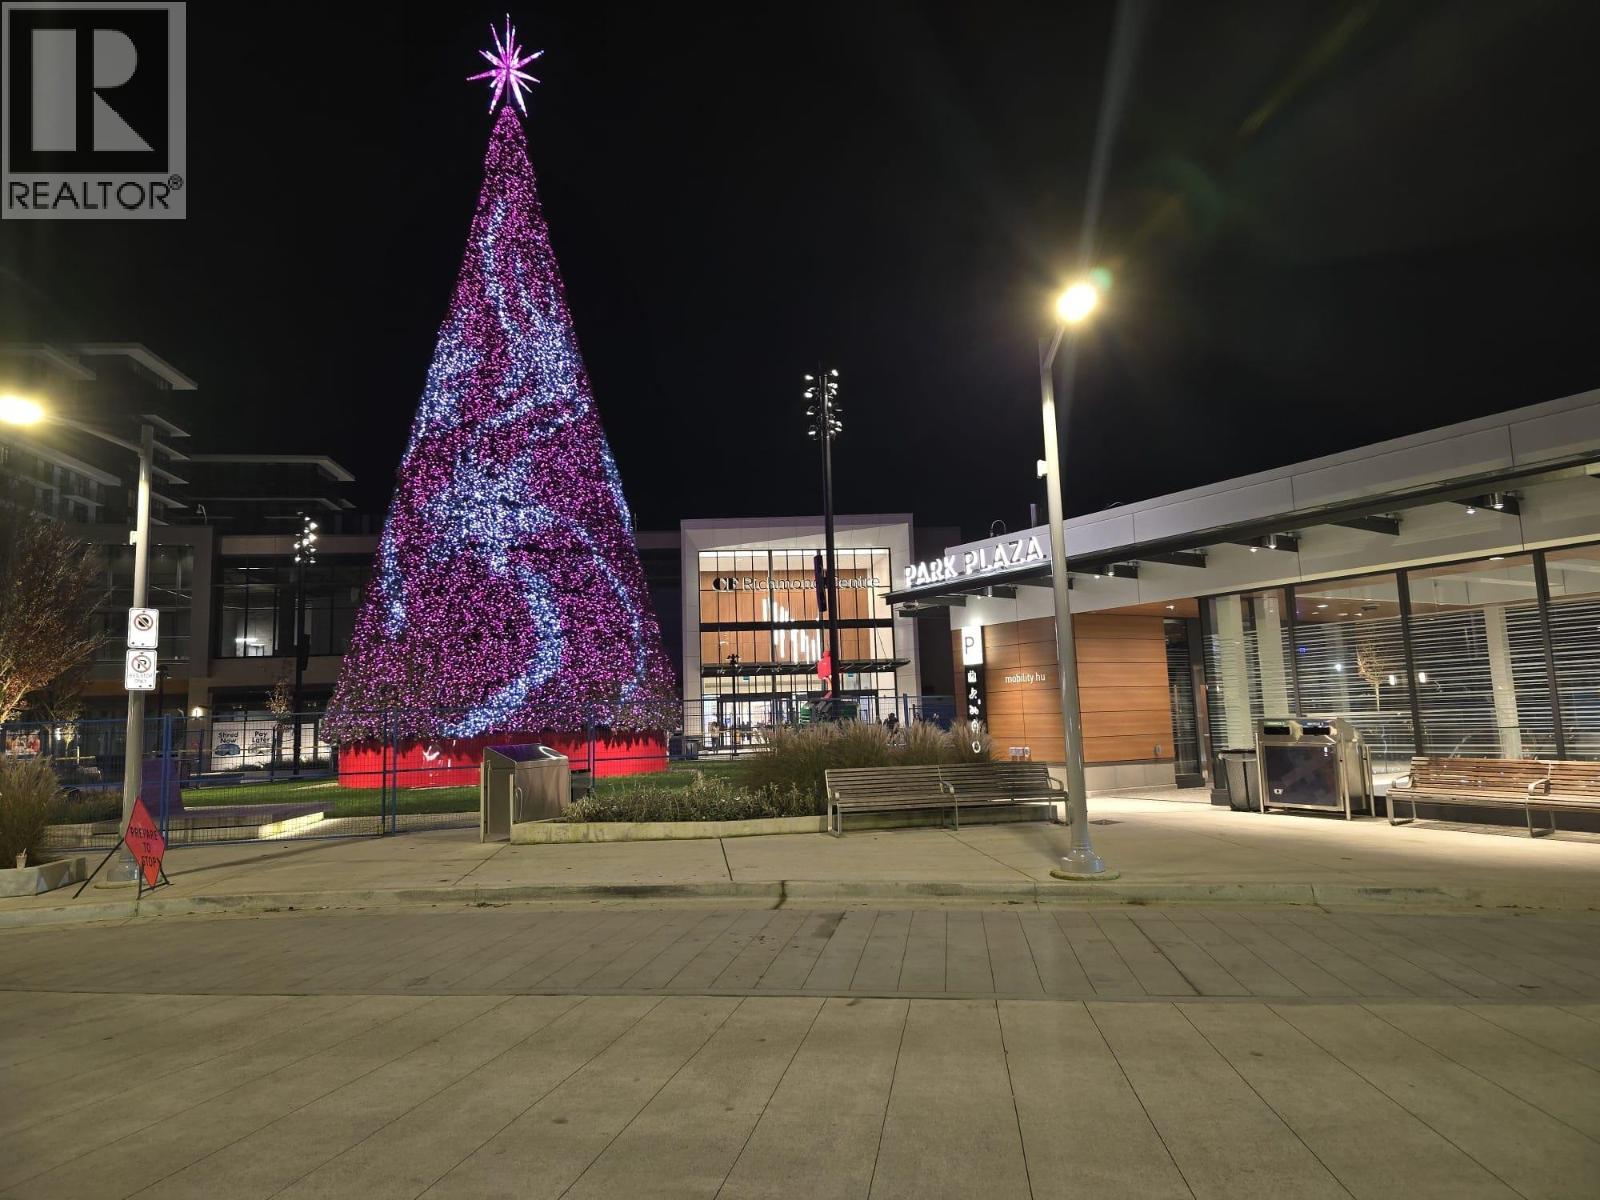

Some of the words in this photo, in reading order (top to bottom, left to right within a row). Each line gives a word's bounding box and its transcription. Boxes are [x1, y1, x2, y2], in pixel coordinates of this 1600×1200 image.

[904, 554, 959, 588] PARK
[964, 536, 1048, 576] PLAZA
[834, 576, 881, 591] entre
[965, 636, 975, 655] P
[1004, 673, 1035, 685] mobility
[218, 731, 239, 739] Shred
[130, 827, 158, 841] PREPARE
[143, 842, 151, 853] TO
[142, 855, 157, 867] STOP
